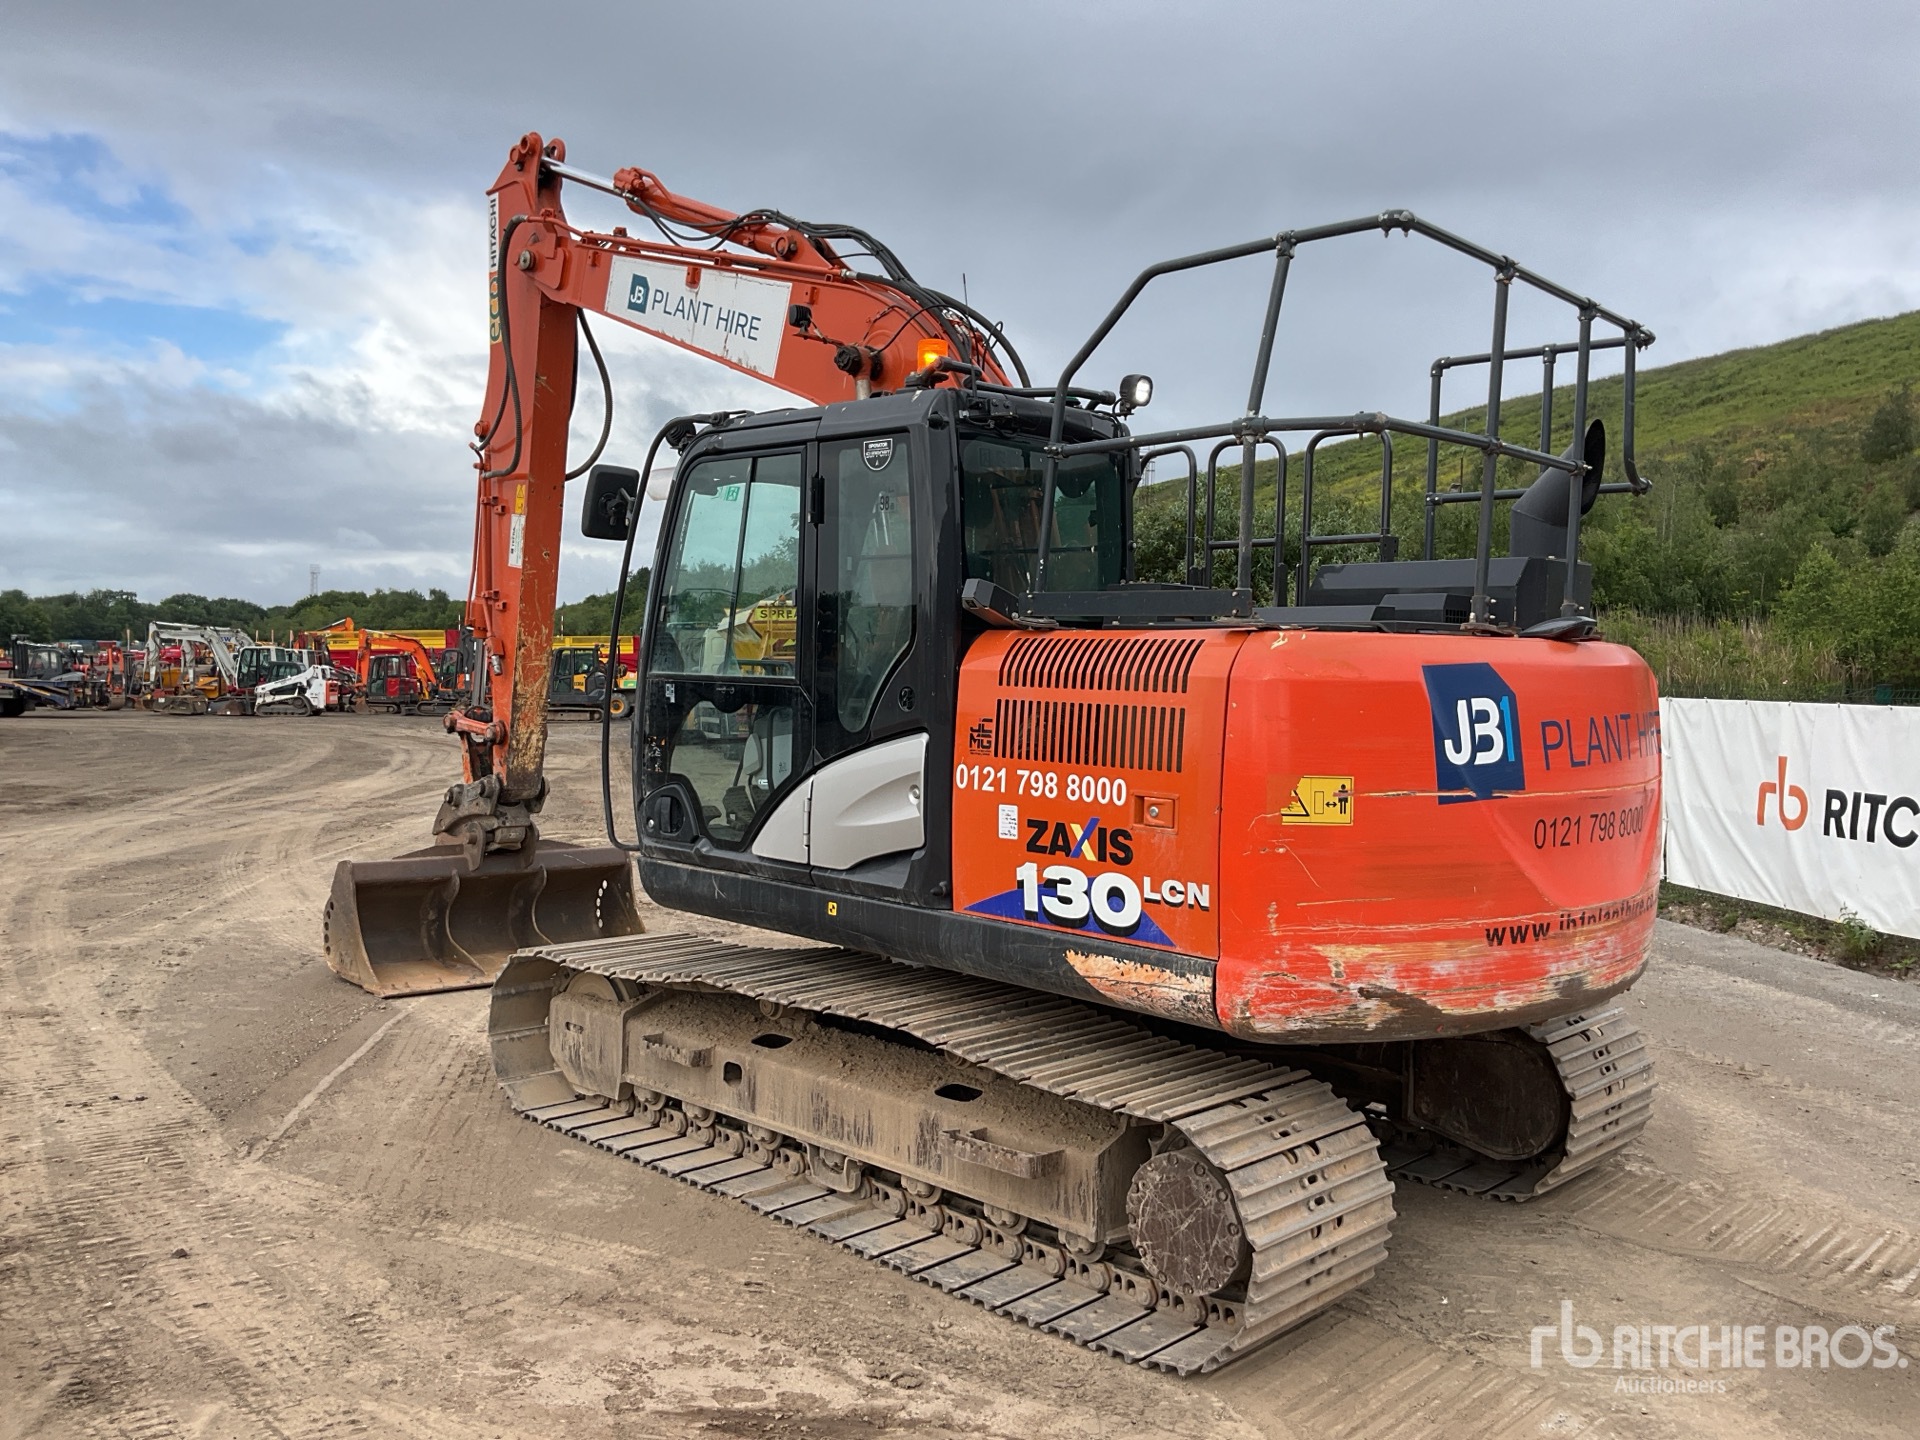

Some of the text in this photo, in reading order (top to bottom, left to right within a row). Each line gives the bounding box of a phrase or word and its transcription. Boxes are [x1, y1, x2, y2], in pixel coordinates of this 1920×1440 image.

[489, 198, 497, 268] HITACHI
[651, 289, 713, 326] PLANT
[716, 306, 761, 341] HIRE
[1540, 714, 1632, 772] PLANT
[955, 763, 1127, 806] 0121 798 8000
[1026, 816, 1134, 866] ZAXIS
[1533, 804, 1644, 850] 0121 798 8000
[1823, 788, 1920, 848] RITC
[1016, 861, 1210, 937] 130 LCN
